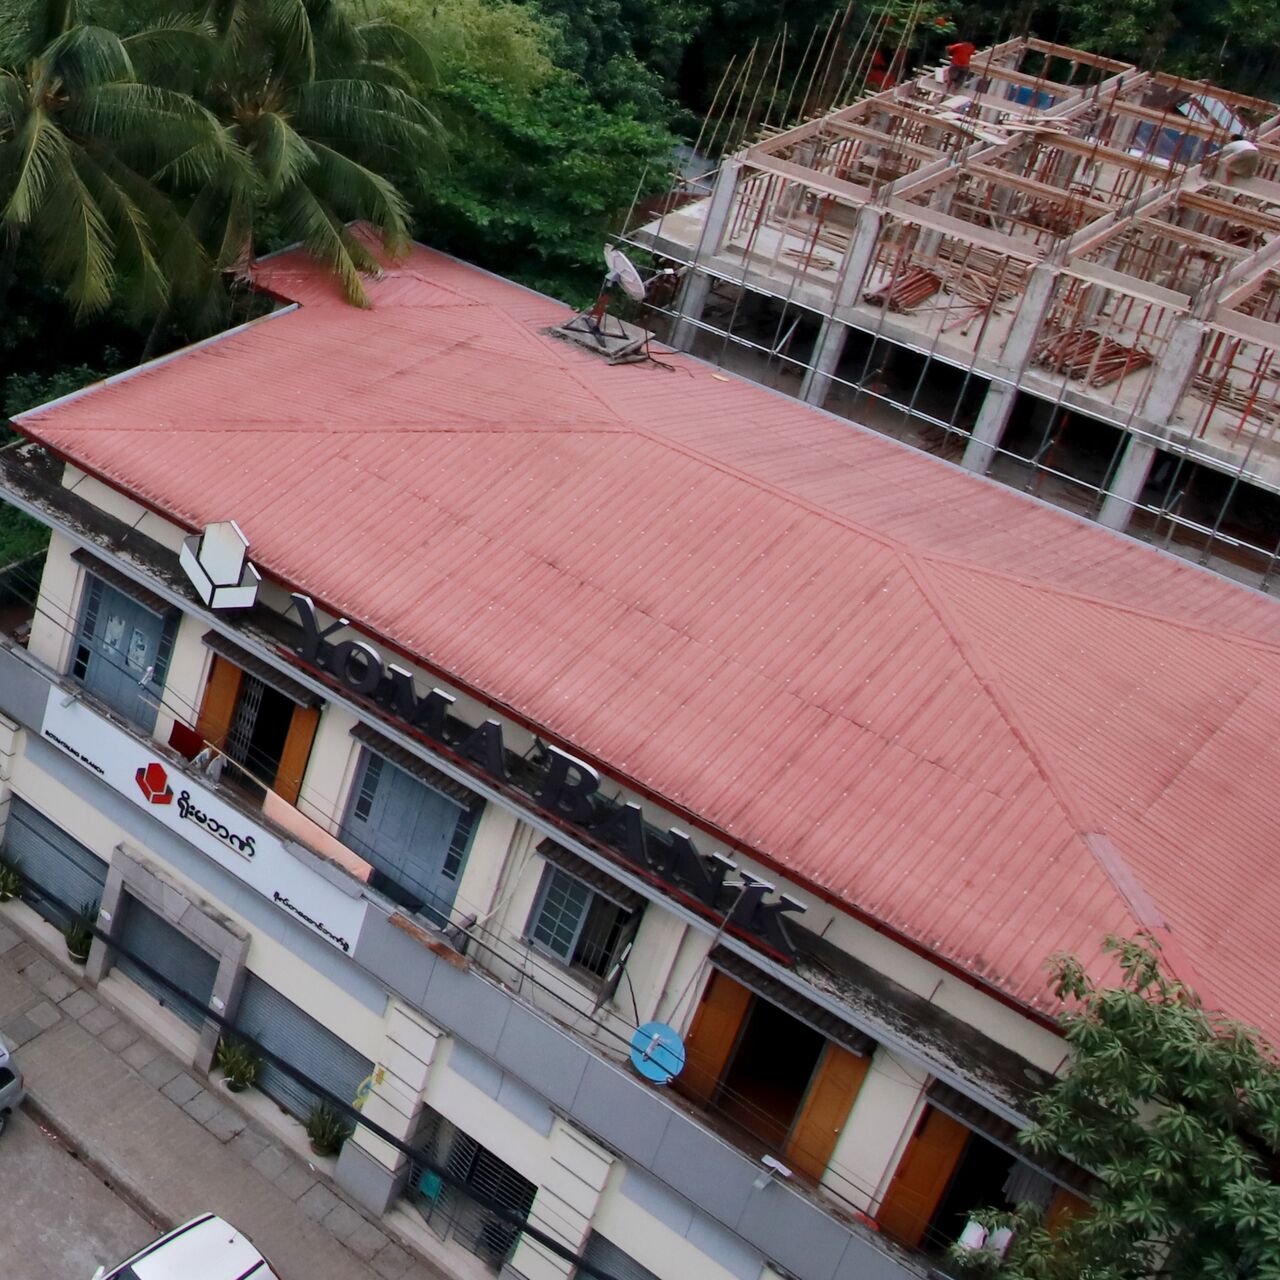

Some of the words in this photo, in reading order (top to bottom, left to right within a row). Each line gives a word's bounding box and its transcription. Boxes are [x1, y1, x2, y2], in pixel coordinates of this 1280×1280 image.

[80, 755, 105, 776] BRANCH
[290, 592, 509, 782] YOMA
[534, 744, 808, 962] BANK
